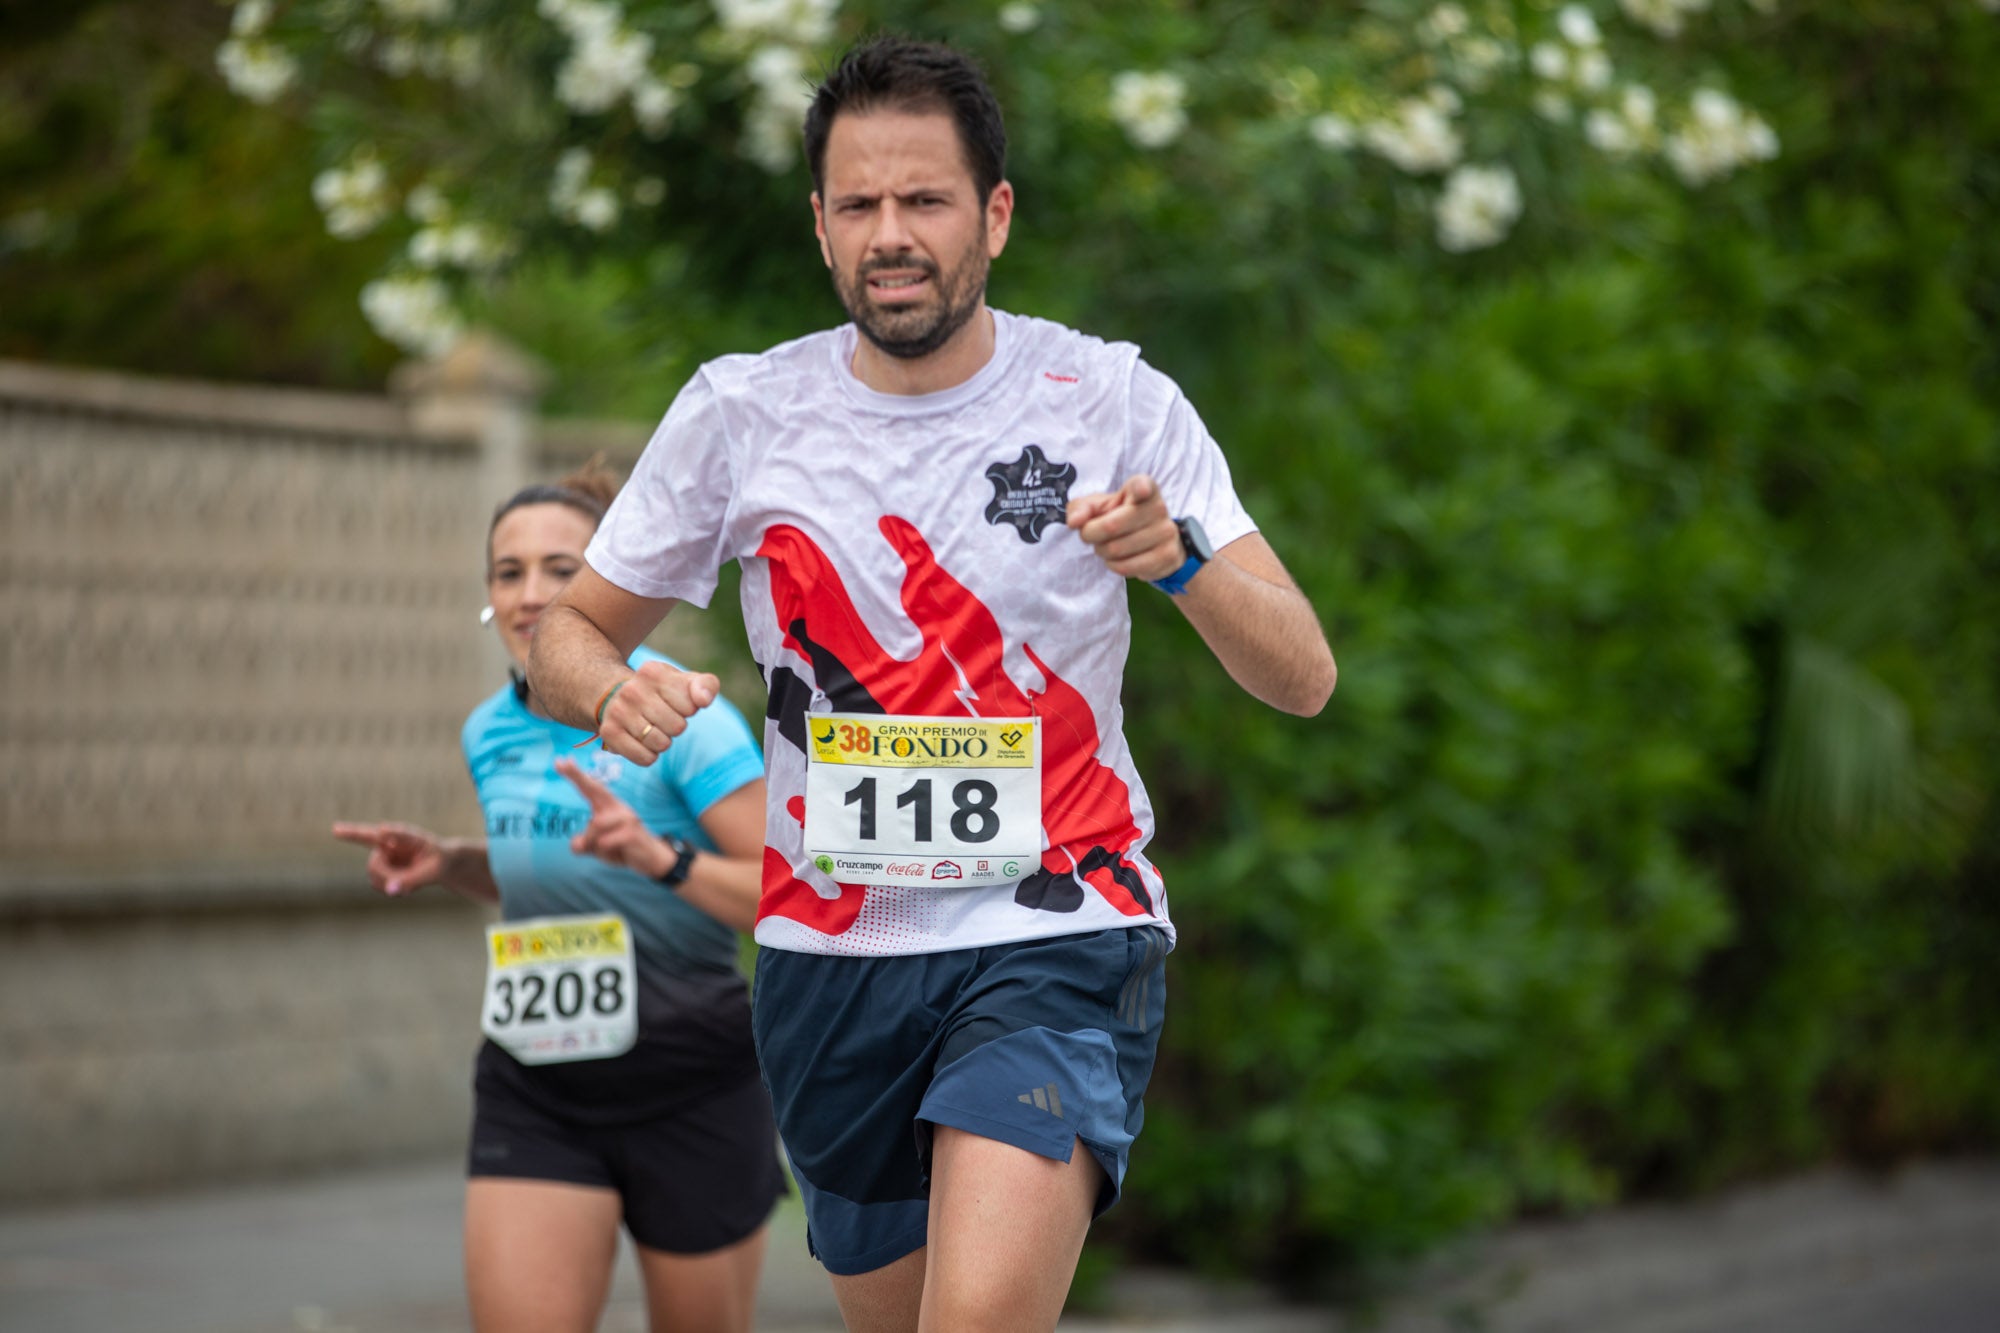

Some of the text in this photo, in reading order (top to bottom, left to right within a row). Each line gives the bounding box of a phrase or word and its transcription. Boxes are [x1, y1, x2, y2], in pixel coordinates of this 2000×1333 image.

[839, 724, 871, 753] 38
[878, 725, 919, 736] GRAN
[922, 726, 977, 737] PREMIO
[872, 736, 988, 758] FONDO
[844, 777, 1000, 843] 118
[836, 860, 883, 871] Cruzcampo
[493, 967, 624, 1025] 3208
